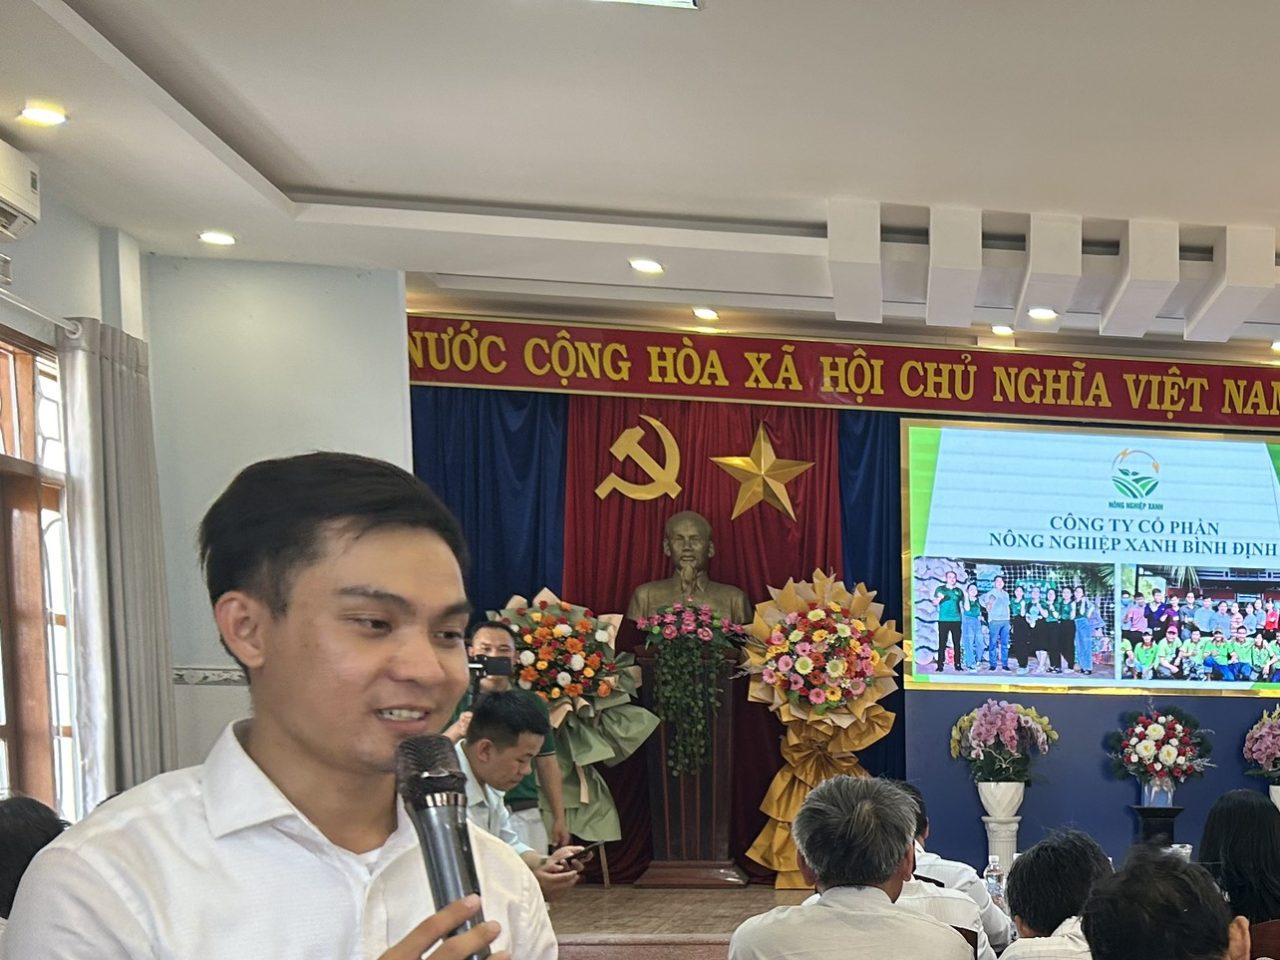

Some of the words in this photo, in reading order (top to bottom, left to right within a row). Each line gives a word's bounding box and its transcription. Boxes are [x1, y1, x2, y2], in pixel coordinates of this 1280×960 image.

[409, 321, 507, 374] NƯỚC
[523, 329, 631, 386] CỘNG
[647, 337, 730, 386] HÒA
[744, 344, 803, 391] XÃ
[819, 347, 885, 403] HỘI
[899, 353, 977, 401] CHỦ
[993, 360, 1112, 408] NGHĨA
[1122, 366, 1209, 420] VIỆT
[1050, 512, 1104, 532] CÔNG
[1109, 518, 1134, 533] TY
[989, 529, 1044, 549] NÔNG
[1049, 534, 1121, 554] NGHIỆP
[1125, 538, 1176, 553] XANH
[1183, 536, 1227, 555] BÌNH
[1232, 541, 1277, 559] ĐỊNH
